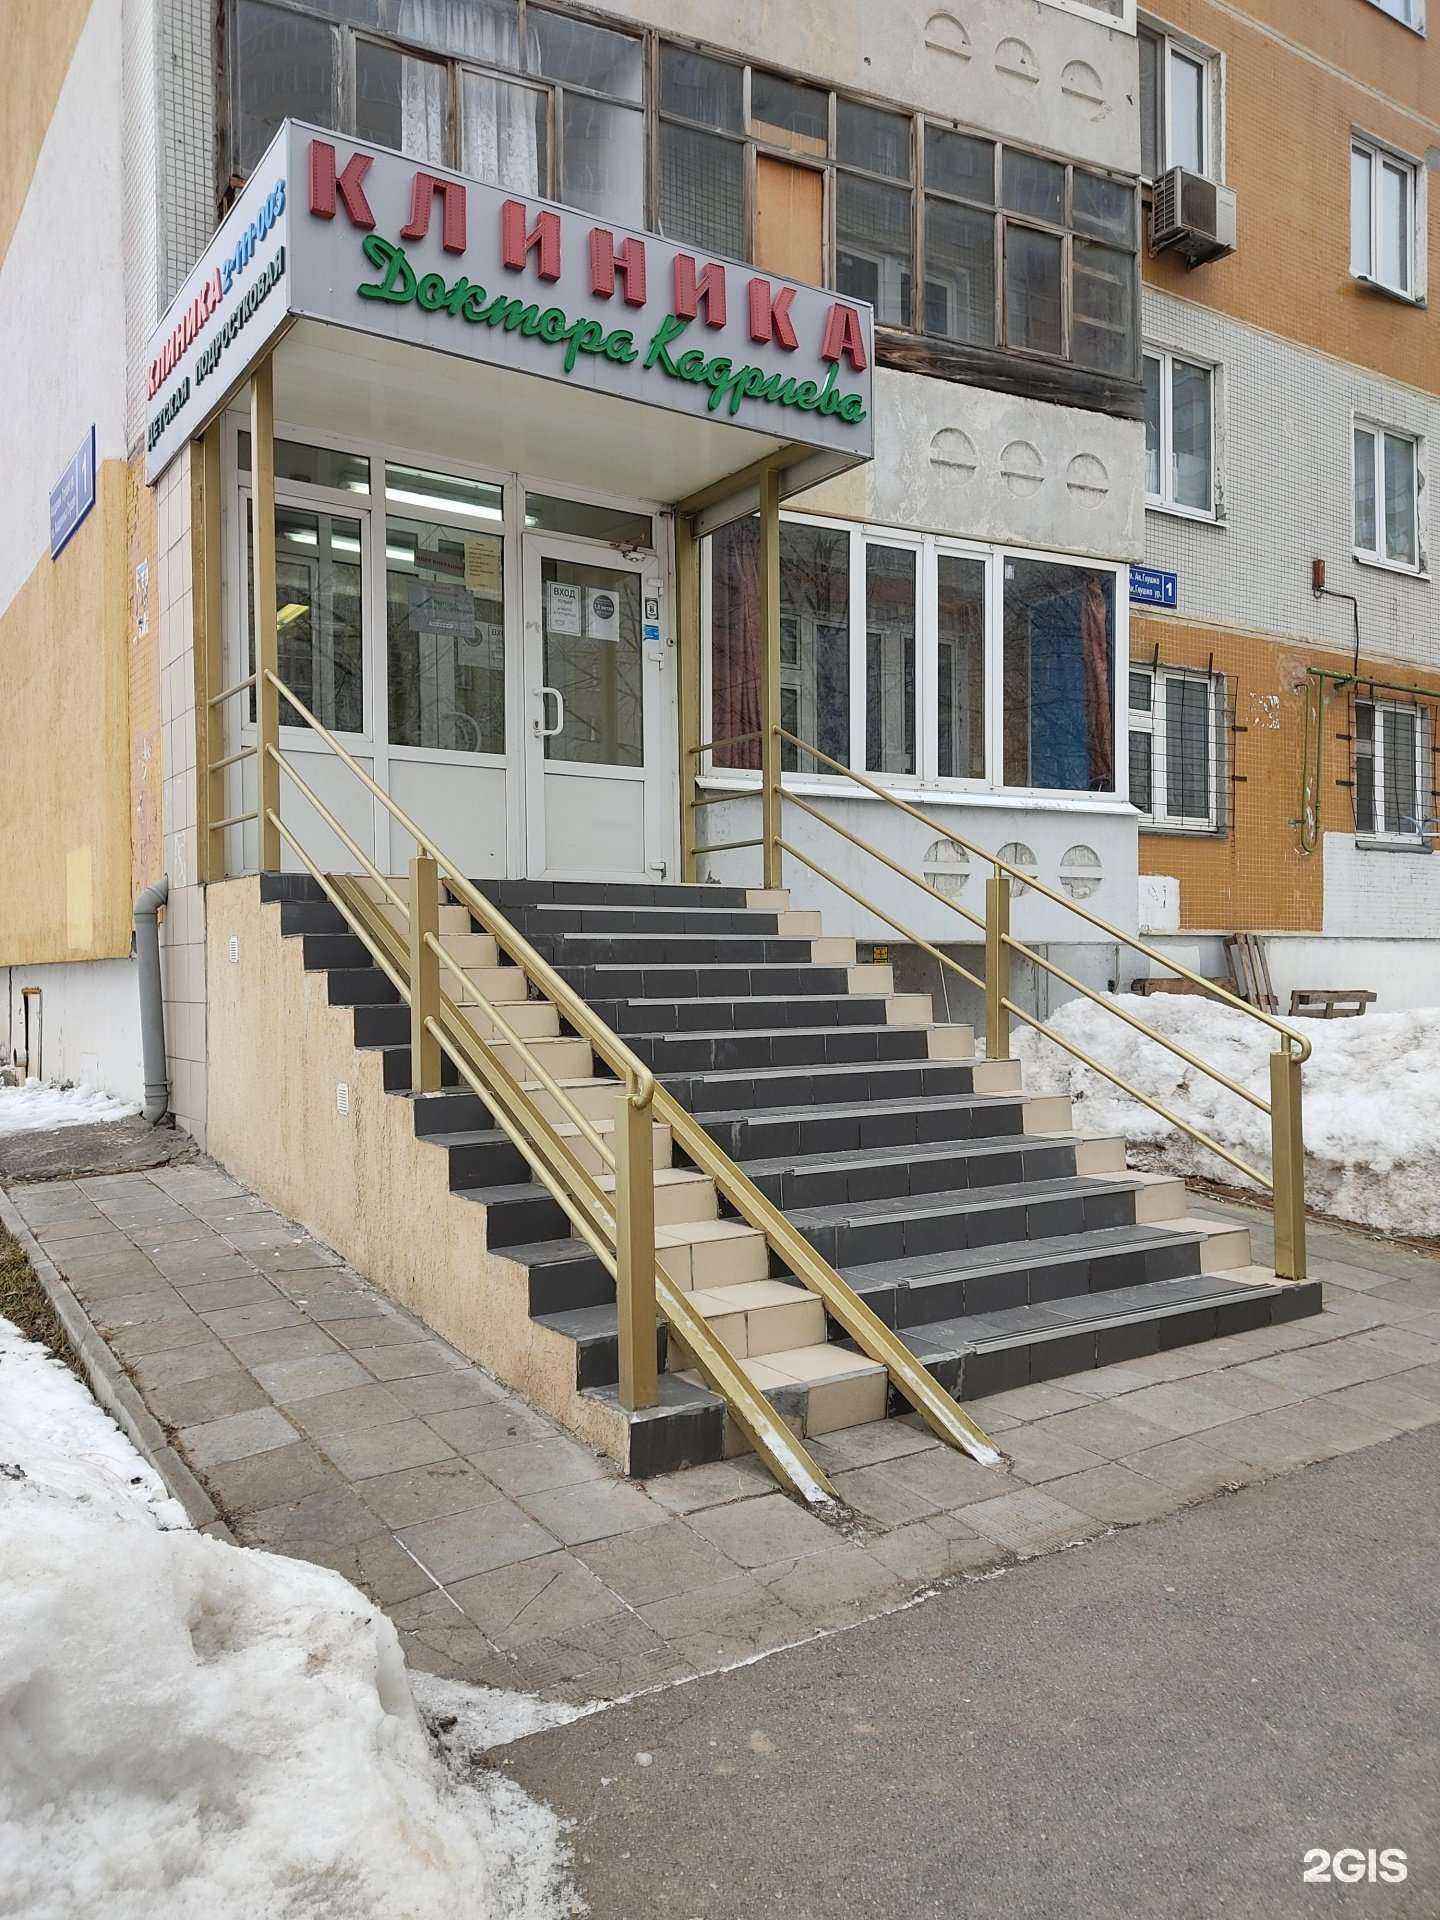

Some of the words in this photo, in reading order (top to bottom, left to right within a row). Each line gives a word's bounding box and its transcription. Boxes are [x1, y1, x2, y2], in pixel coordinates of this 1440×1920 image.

[146, 266, 224, 401] КЛИНИКА
[309, 138, 868, 372] КЛИНИКА
[356, 233, 639, 374] Доктора
[642, 313, 868, 425] Кадриева
[147, 375, 191, 452] ДЕТСКАЯ
[194, 245, 287, 387] ПОДРОСТКОВАЯ
[553, 586, 576, 599] ВХОД
[1165, 582, 1173, 597] 1
